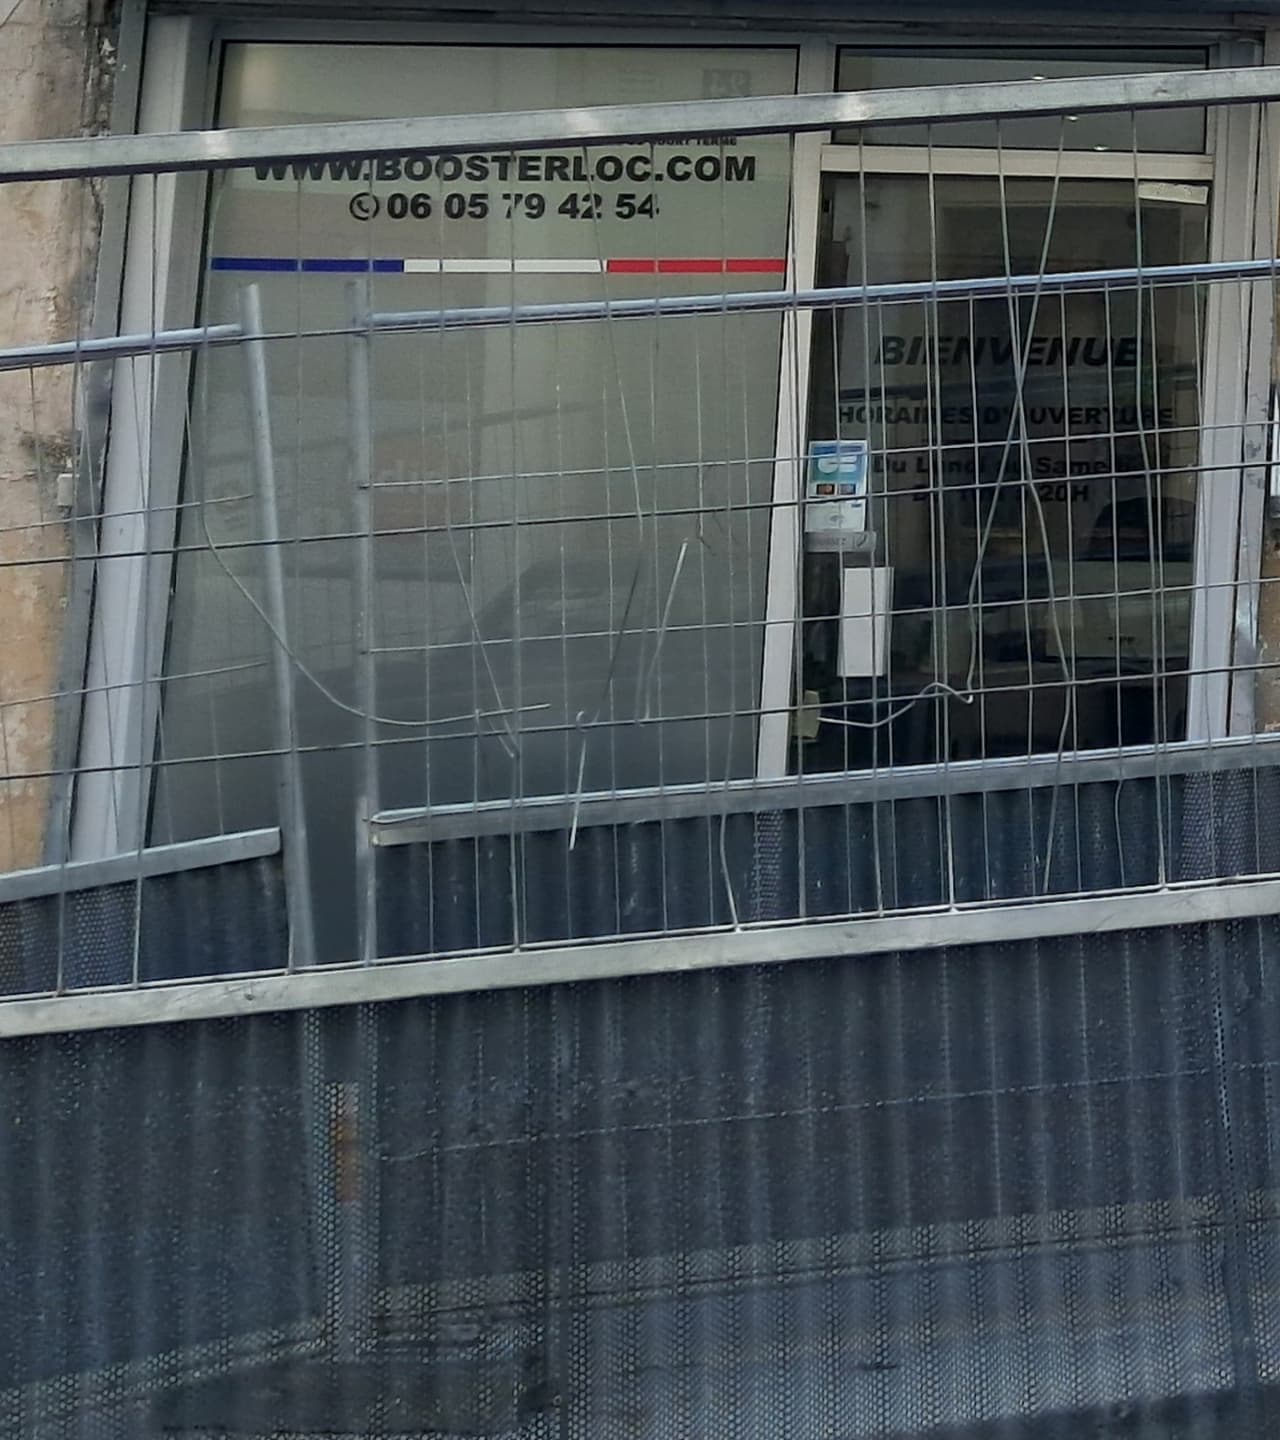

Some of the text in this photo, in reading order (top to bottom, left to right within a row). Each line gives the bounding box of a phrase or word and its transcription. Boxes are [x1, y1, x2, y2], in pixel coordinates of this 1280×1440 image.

[254, 154, 756, 182] WWW.BOOSTERLOC.COM
[386, 193, 660, 219] 06 05 79 42 54
[874, 335, 1142, 367] BIENVENUE
[983, 406, 1174, 426] D'UVERTURE
